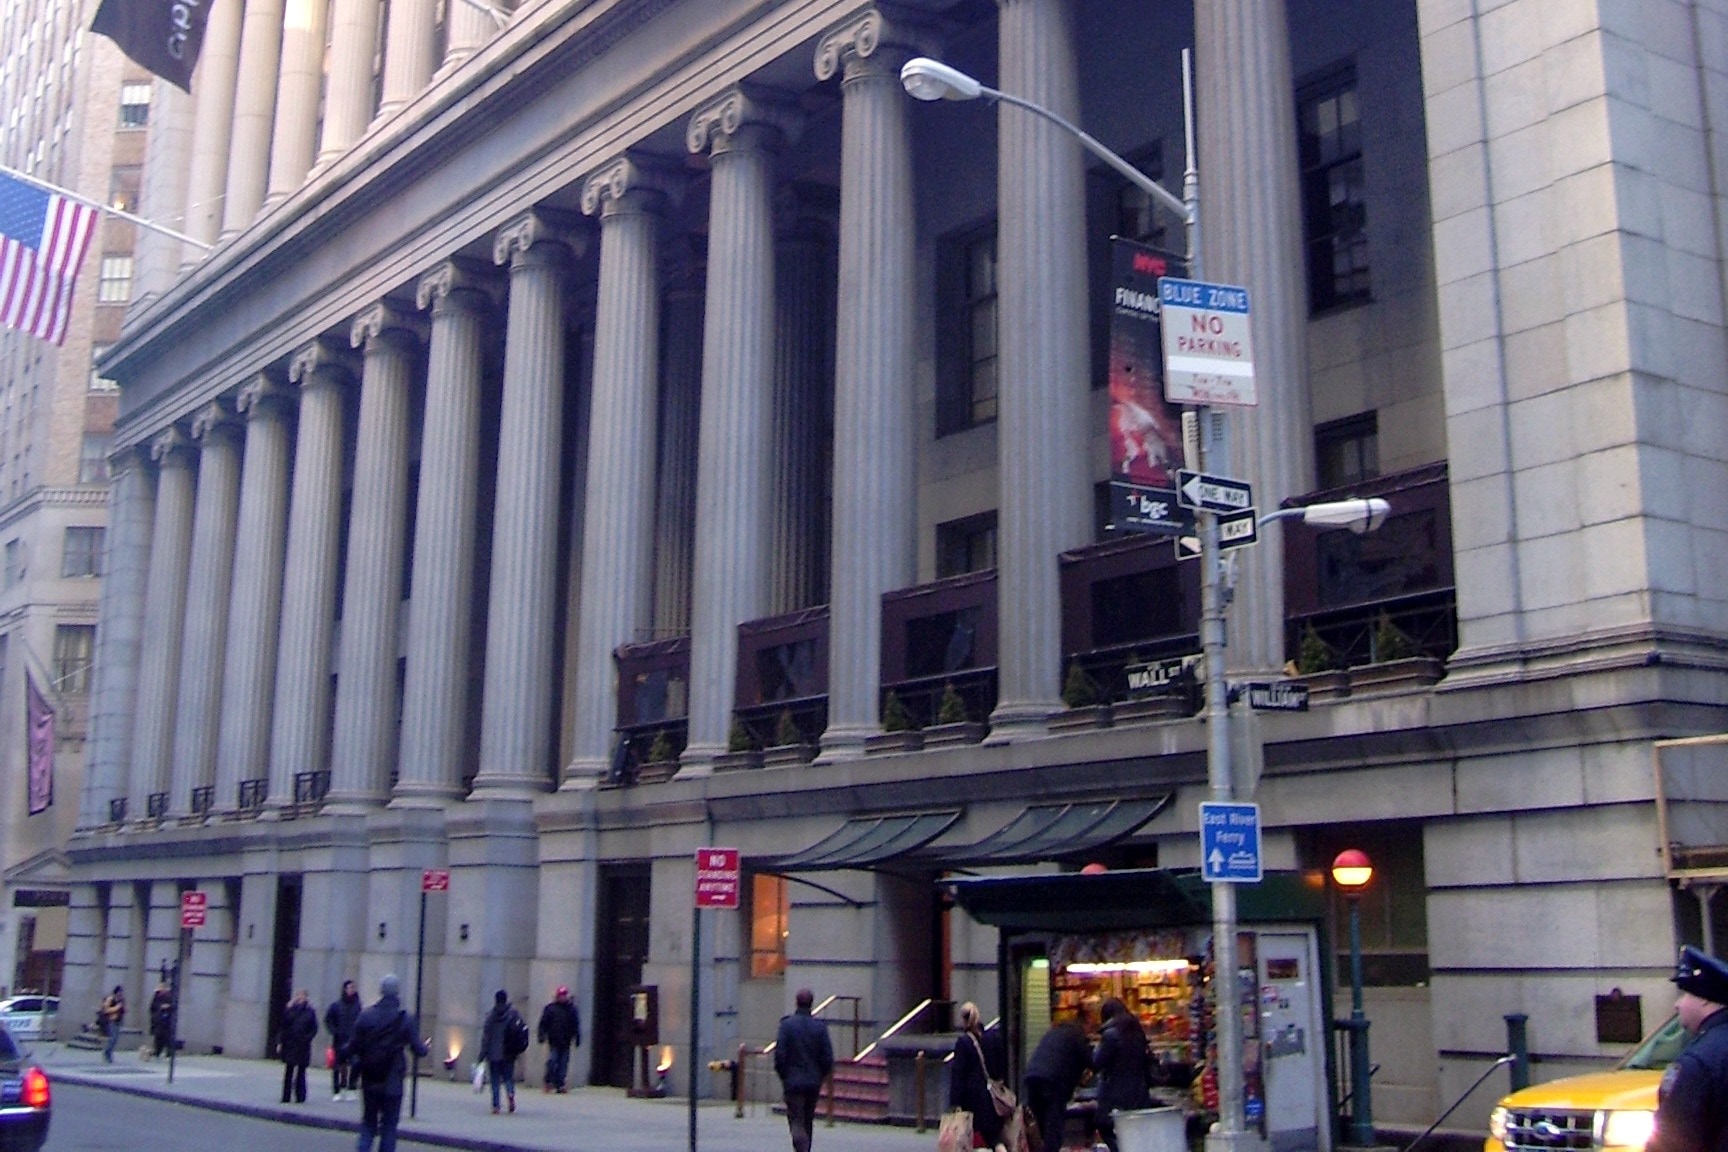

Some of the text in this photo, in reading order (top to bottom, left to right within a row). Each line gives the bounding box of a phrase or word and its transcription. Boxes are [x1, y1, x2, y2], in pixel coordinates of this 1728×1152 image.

[1163, 283, 1247, 309] BLUE ZONE
[1191, 314, 1223, 335] NO
[1178, 336, 1241, 357] PARKING
[1200, 485, 1244, 505] ONE WAY
[1226, 522, 1247, 537] WAY
[1128, 668, 1170, 690] WALL
[1203, 812, 1255, 826] East River
[1215, 831, 1246, 847] Ferry
[709, 854, 727, 868] NO
